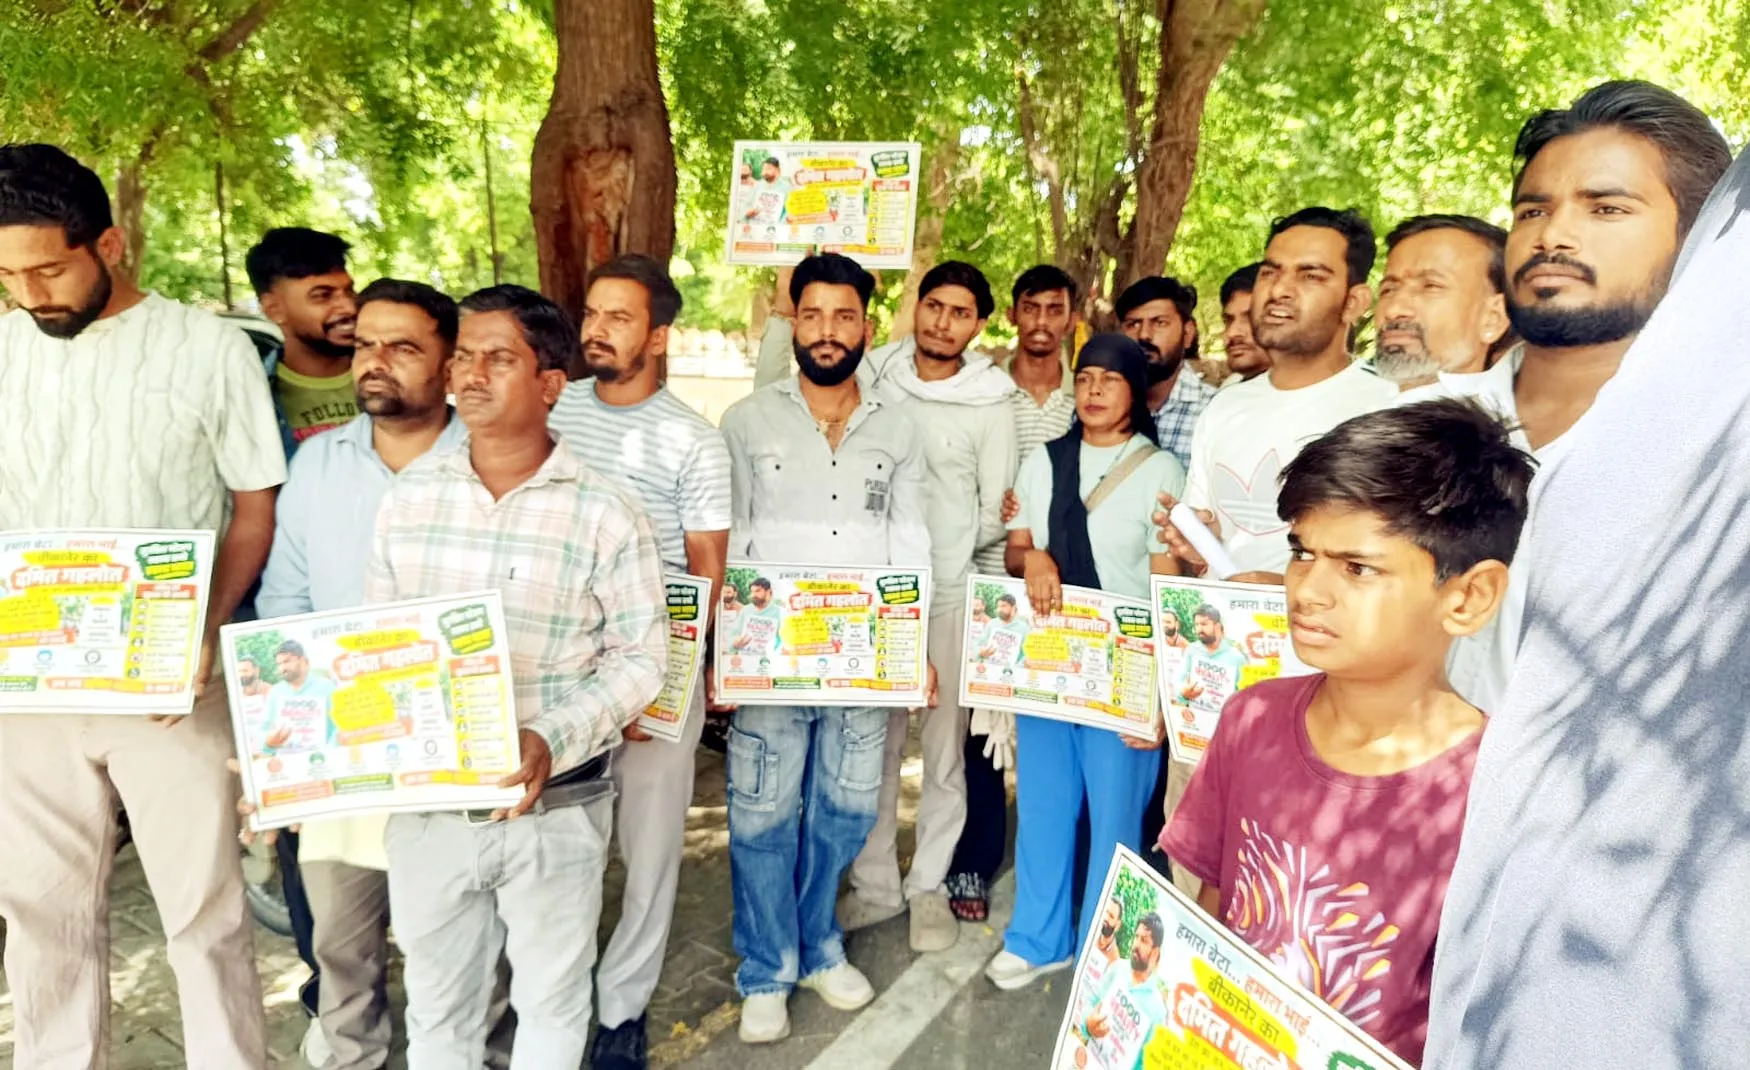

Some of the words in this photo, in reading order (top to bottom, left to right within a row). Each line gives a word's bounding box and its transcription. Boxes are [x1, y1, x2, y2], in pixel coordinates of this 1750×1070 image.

[1230, 600, 1259, 610] हमारा
[1176, 922, 1206, 955] हमारा
[1244, 974, 1284, 1013] हमारा
[1208, 974, 1257, 1022] बीकानेर
[1259, 1017, 1280, 1045] का
